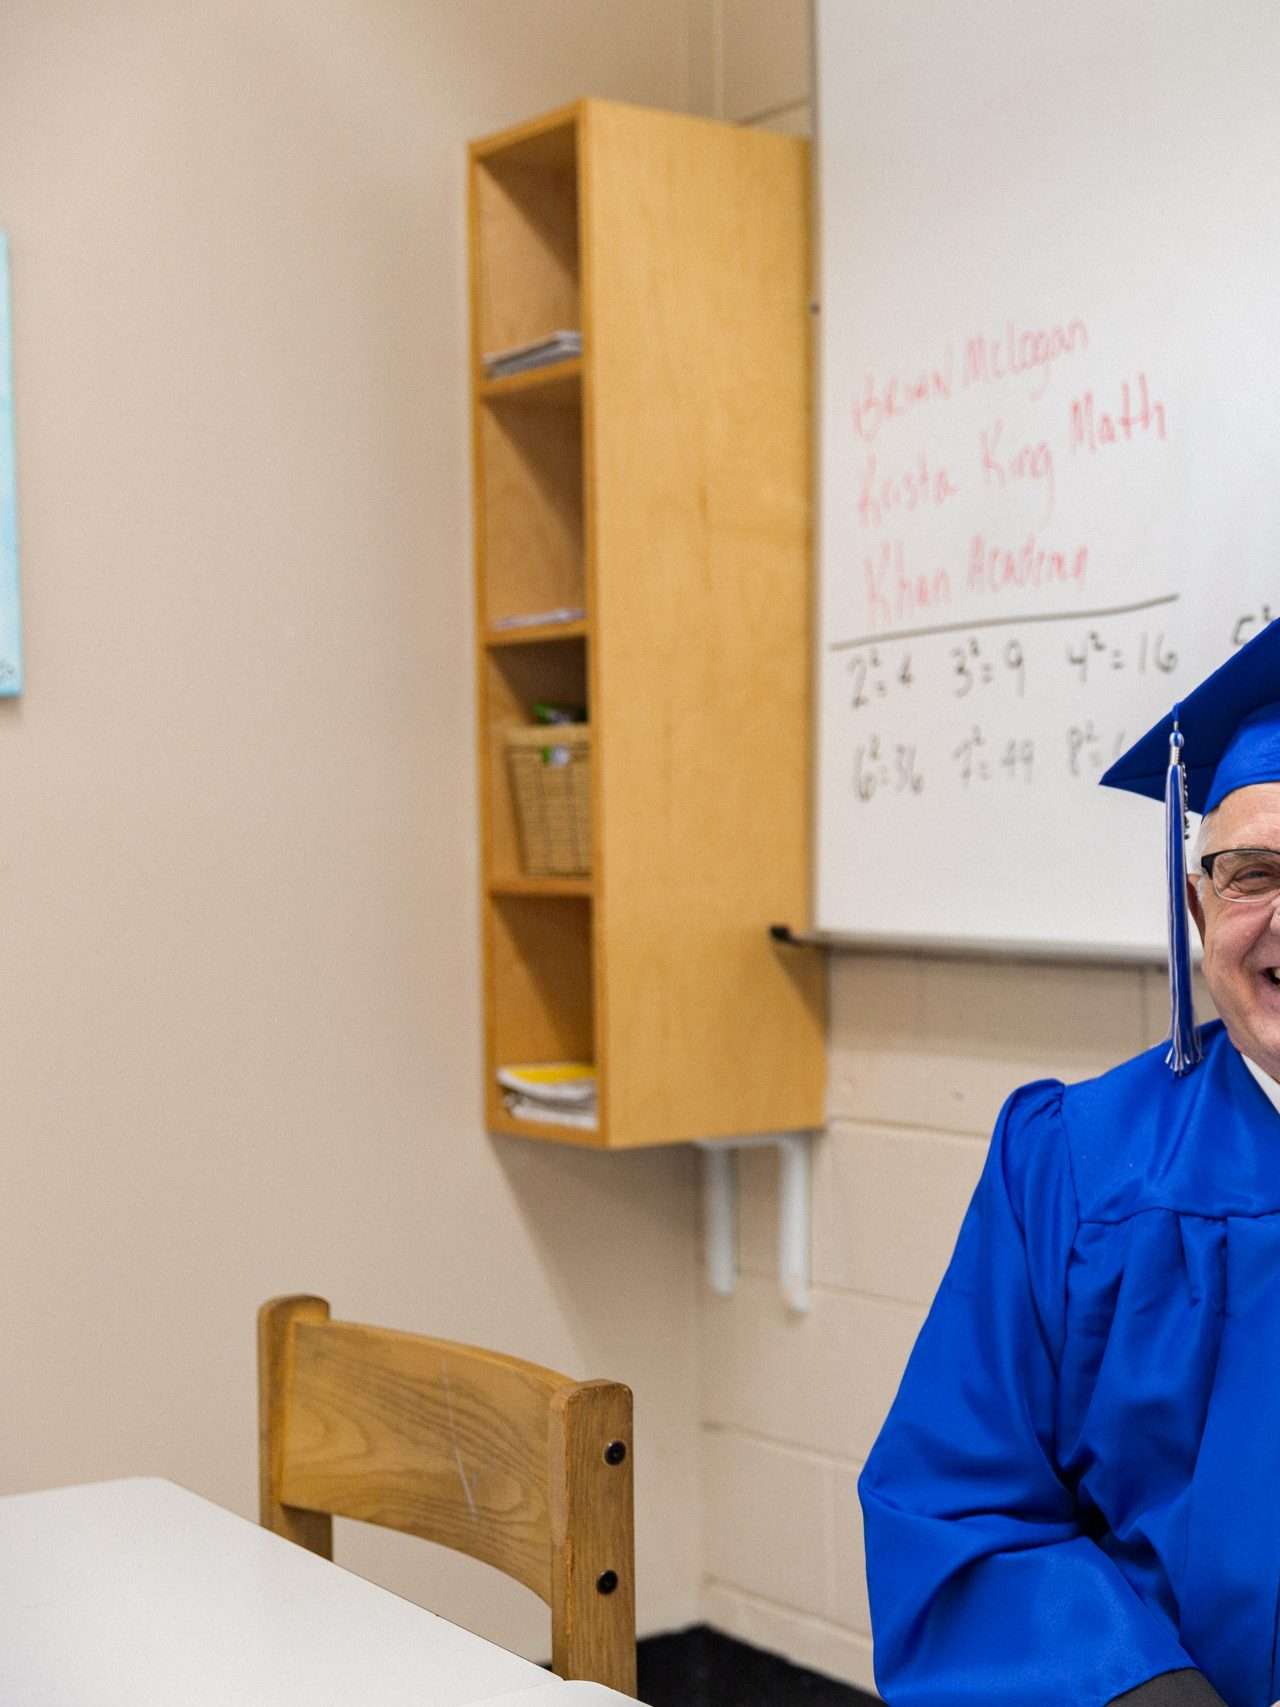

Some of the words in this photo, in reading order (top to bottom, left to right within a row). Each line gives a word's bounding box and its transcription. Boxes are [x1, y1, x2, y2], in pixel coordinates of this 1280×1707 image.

[980, 417, 1055, 527] King
[1070, 371, 1167, 454] Math
[864, 541, 951, 625] Khan
